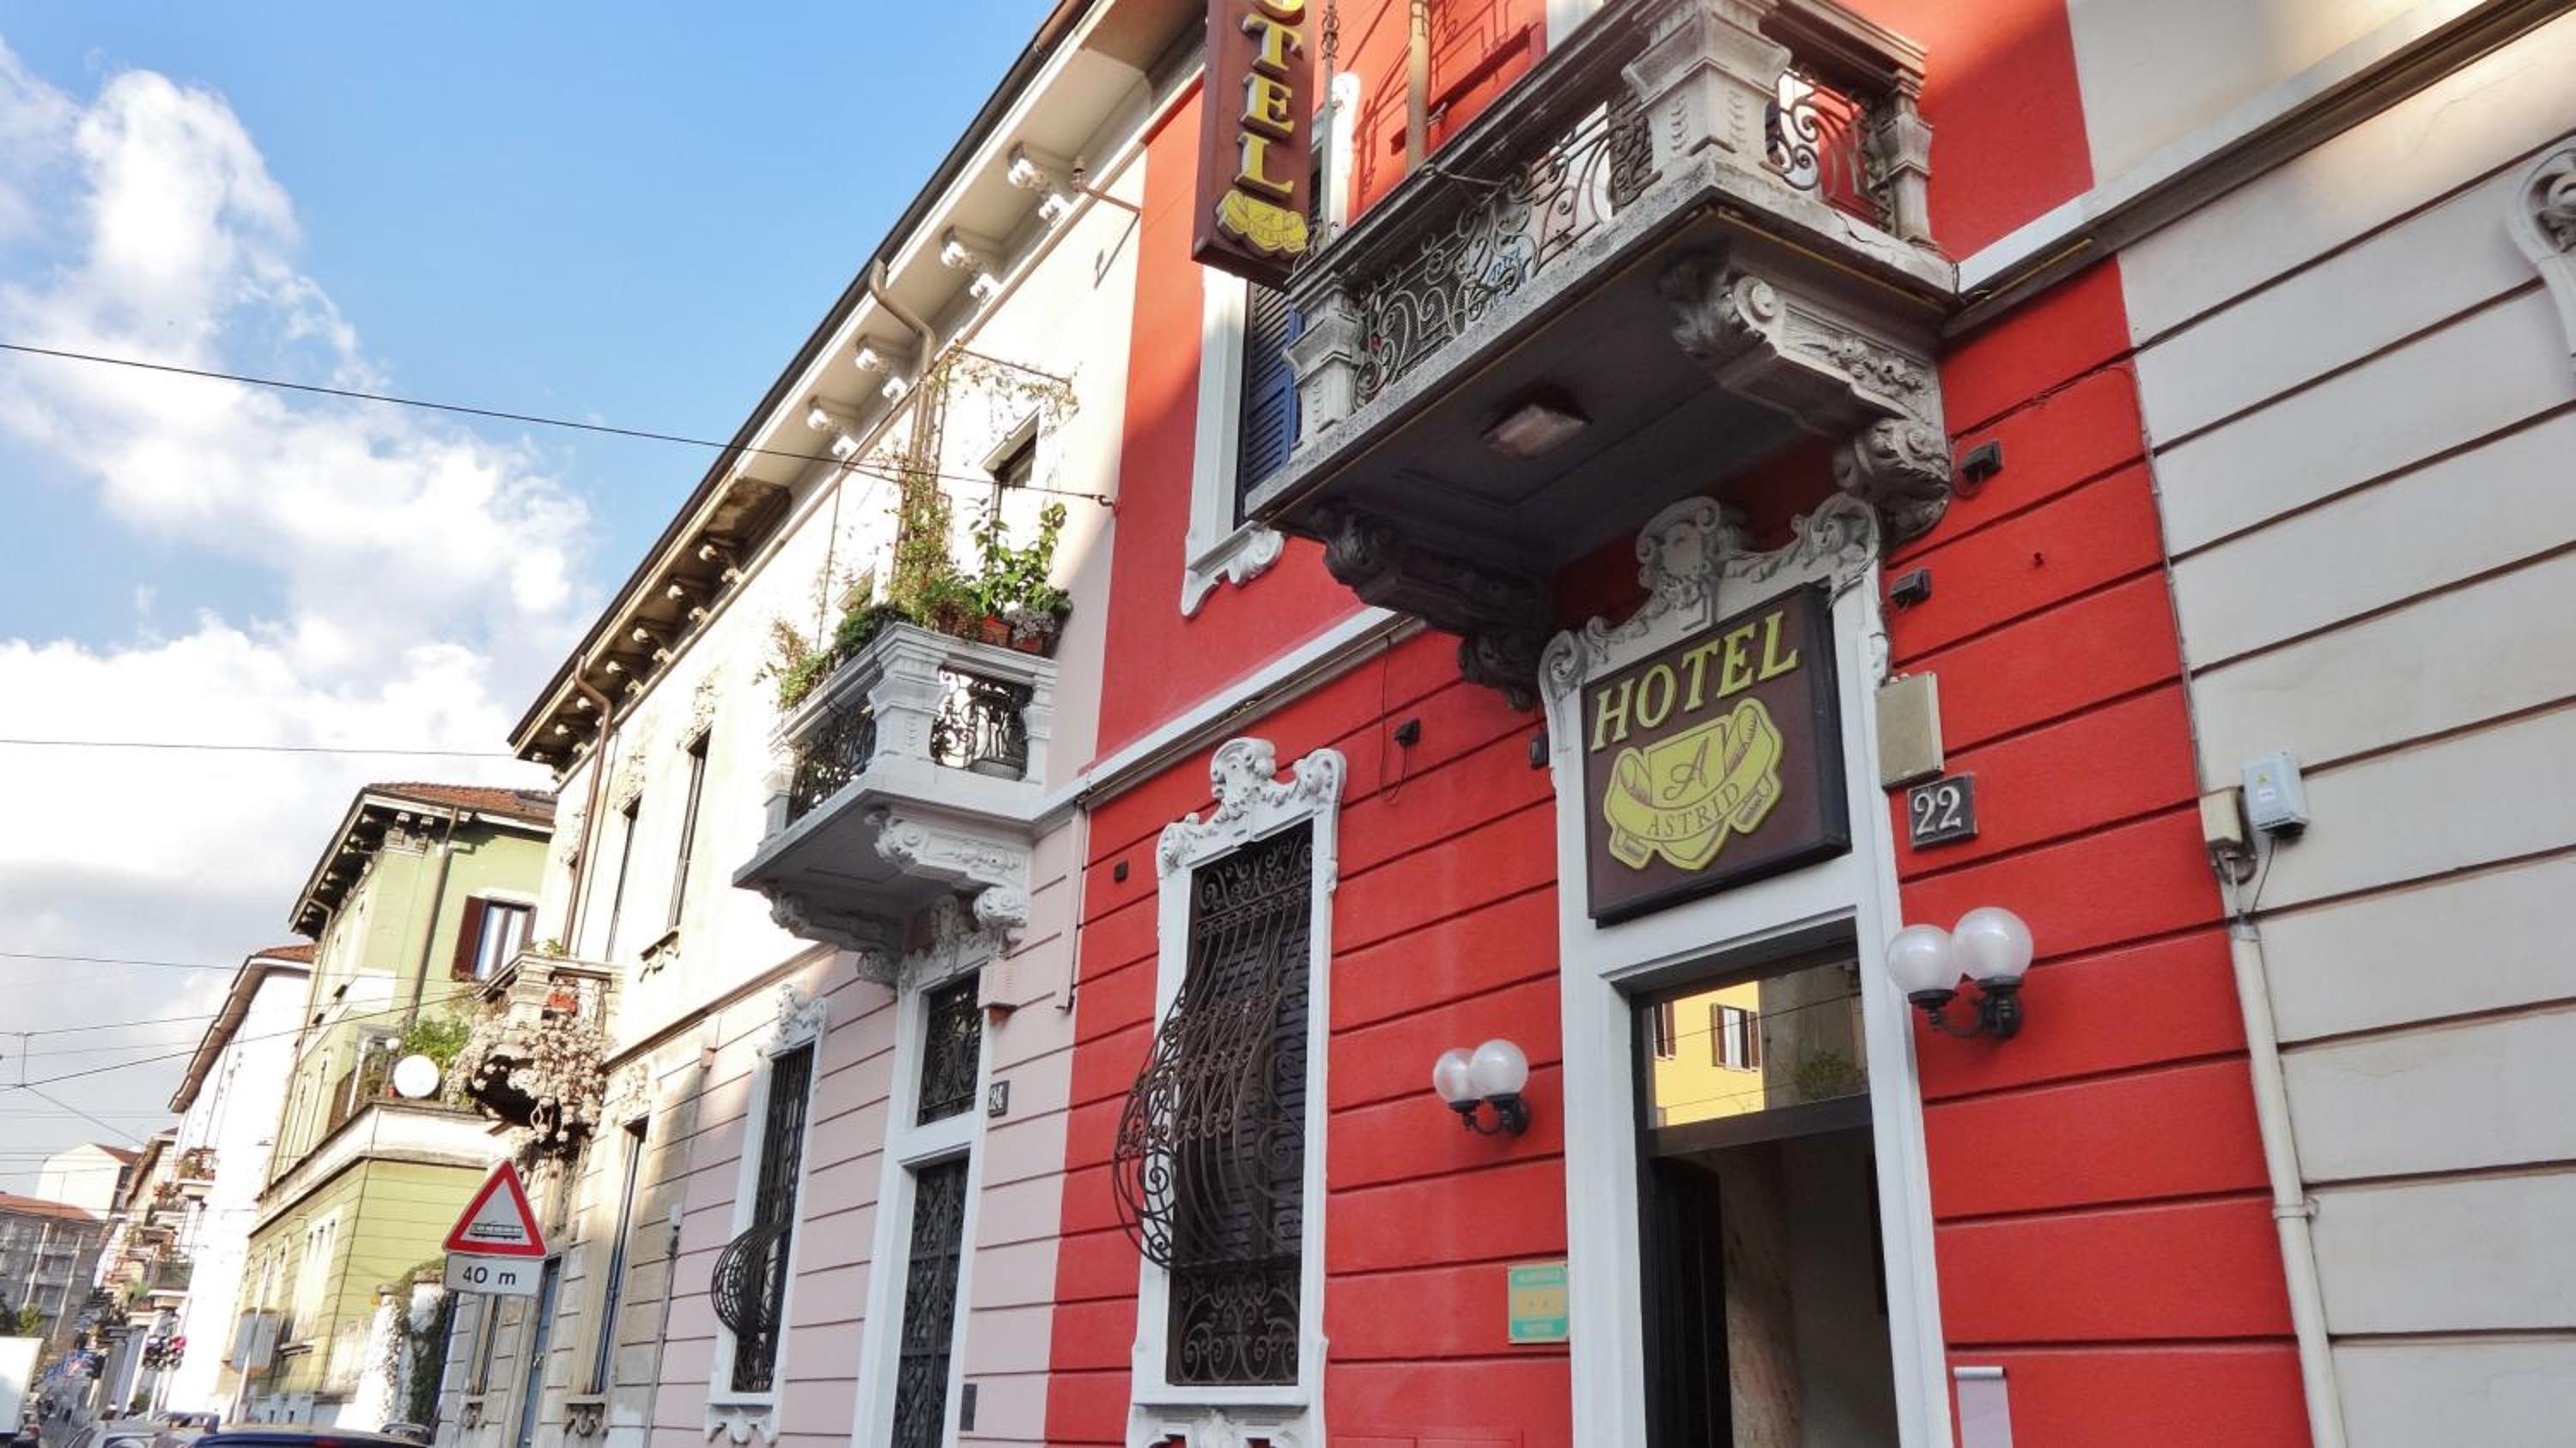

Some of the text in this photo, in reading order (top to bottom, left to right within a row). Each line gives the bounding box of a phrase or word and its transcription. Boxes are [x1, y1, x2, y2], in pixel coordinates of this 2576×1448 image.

[1233, 0, 1305, 194] TEL
[1590, 610, 1798, 752] HOTEL
[1647, 782, 1741, 837] ASTRID
[1914, 785, 1962, 836] 22
[463, 1266, 516, 1285] 40 m
